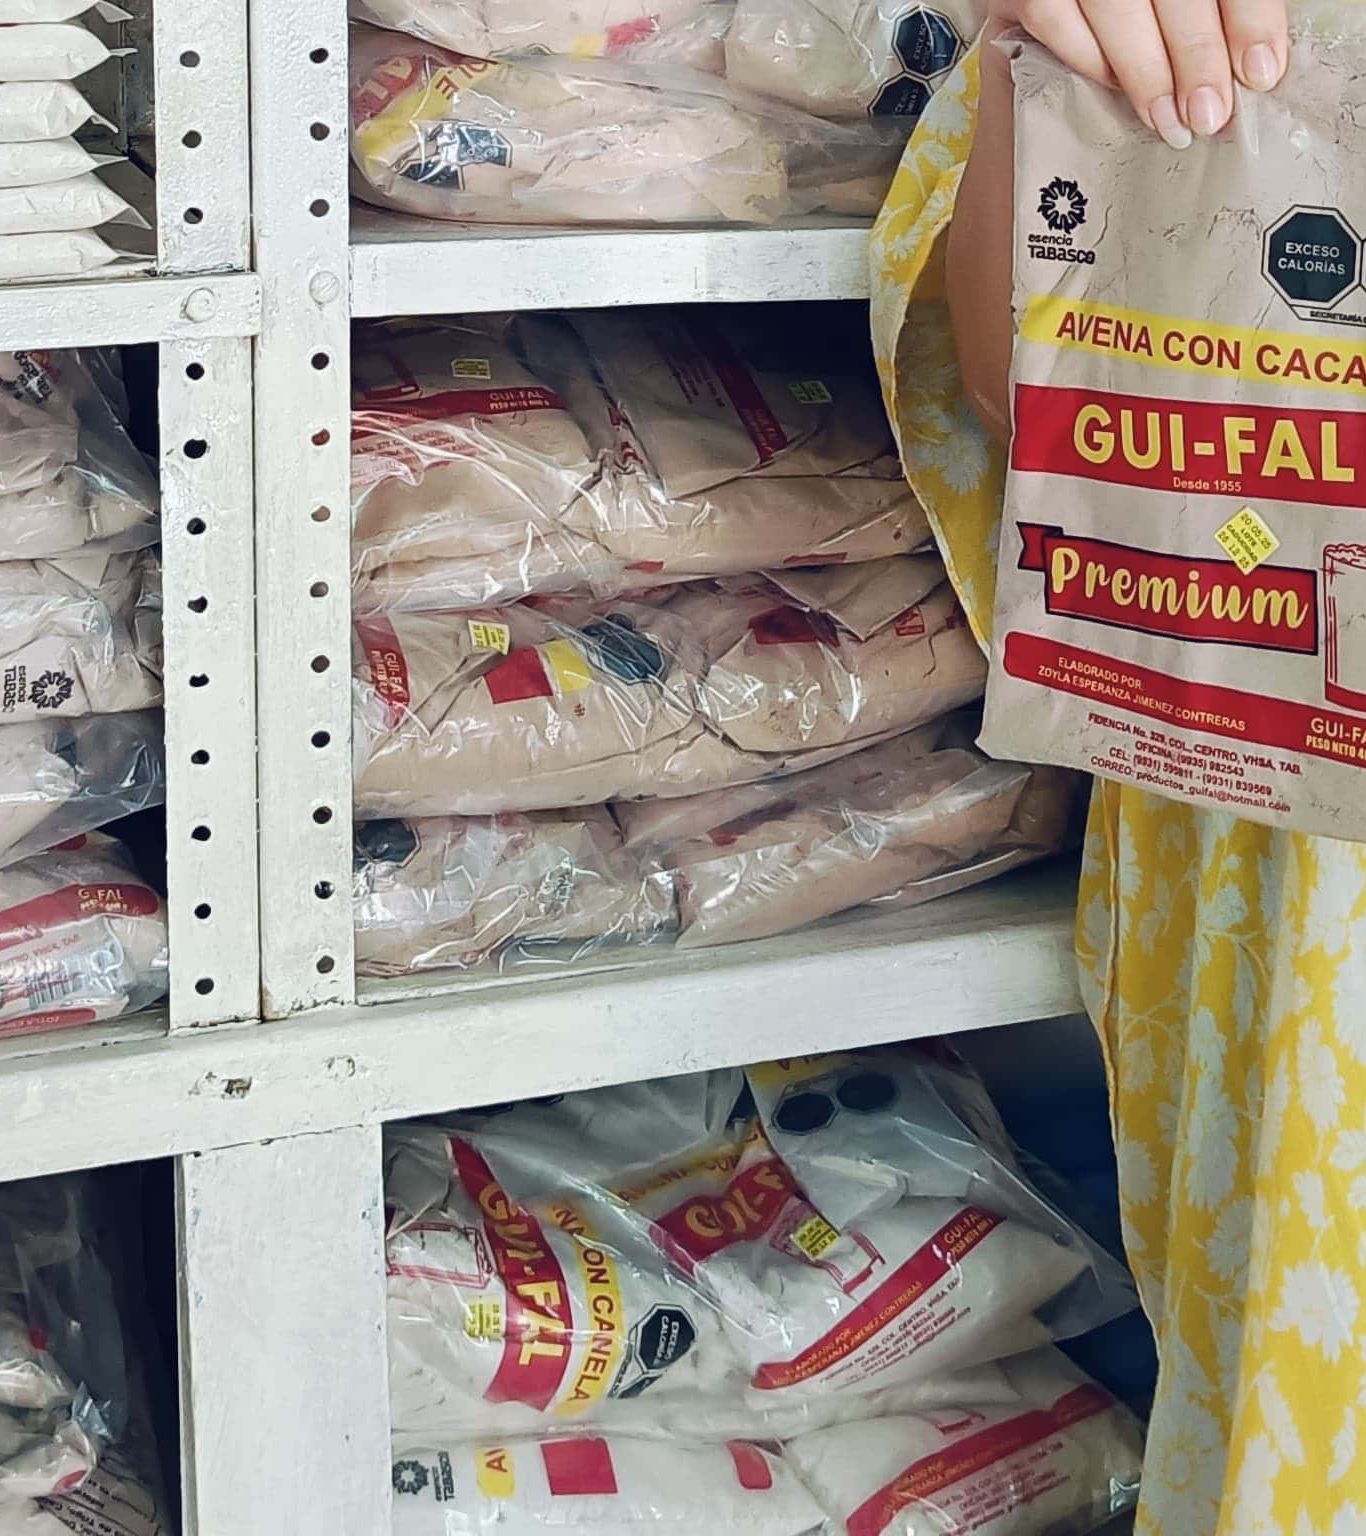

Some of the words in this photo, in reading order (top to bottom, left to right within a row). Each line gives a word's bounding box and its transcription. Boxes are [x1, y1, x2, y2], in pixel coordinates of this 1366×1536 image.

[1285, 242, 1341, 259] EXCESO
[1278, 257, 1347, 276] CALORÍAS
[1056, 310, 1153, 357] AVENA
[1162, 330, 1242, 370] CON
[1073, 403, 1356, 484] GUI-FAL
[1172, 476, 1210, 491] Desde
[1213, 479, 1242, 493] 1955
[1049, 546, 1308, 630] Premium
[1058, 656, 1119, 684] ELABORADO
[1038, 665, 1071, 685] ZOYLA
[1072, 675, 1131, 702] ESPERANZA
[1133, 691, 1174, 716] JIMENEZ
[1175, 706, 1246, 732] CONTRERAS
[1088, 711, 1131, 735] FIDENCIA
[1306, 735, 1331, 752] PESO
[1332, 741, 1356, 758] NETO
[568, 1295, 616, 1402] CANELA
